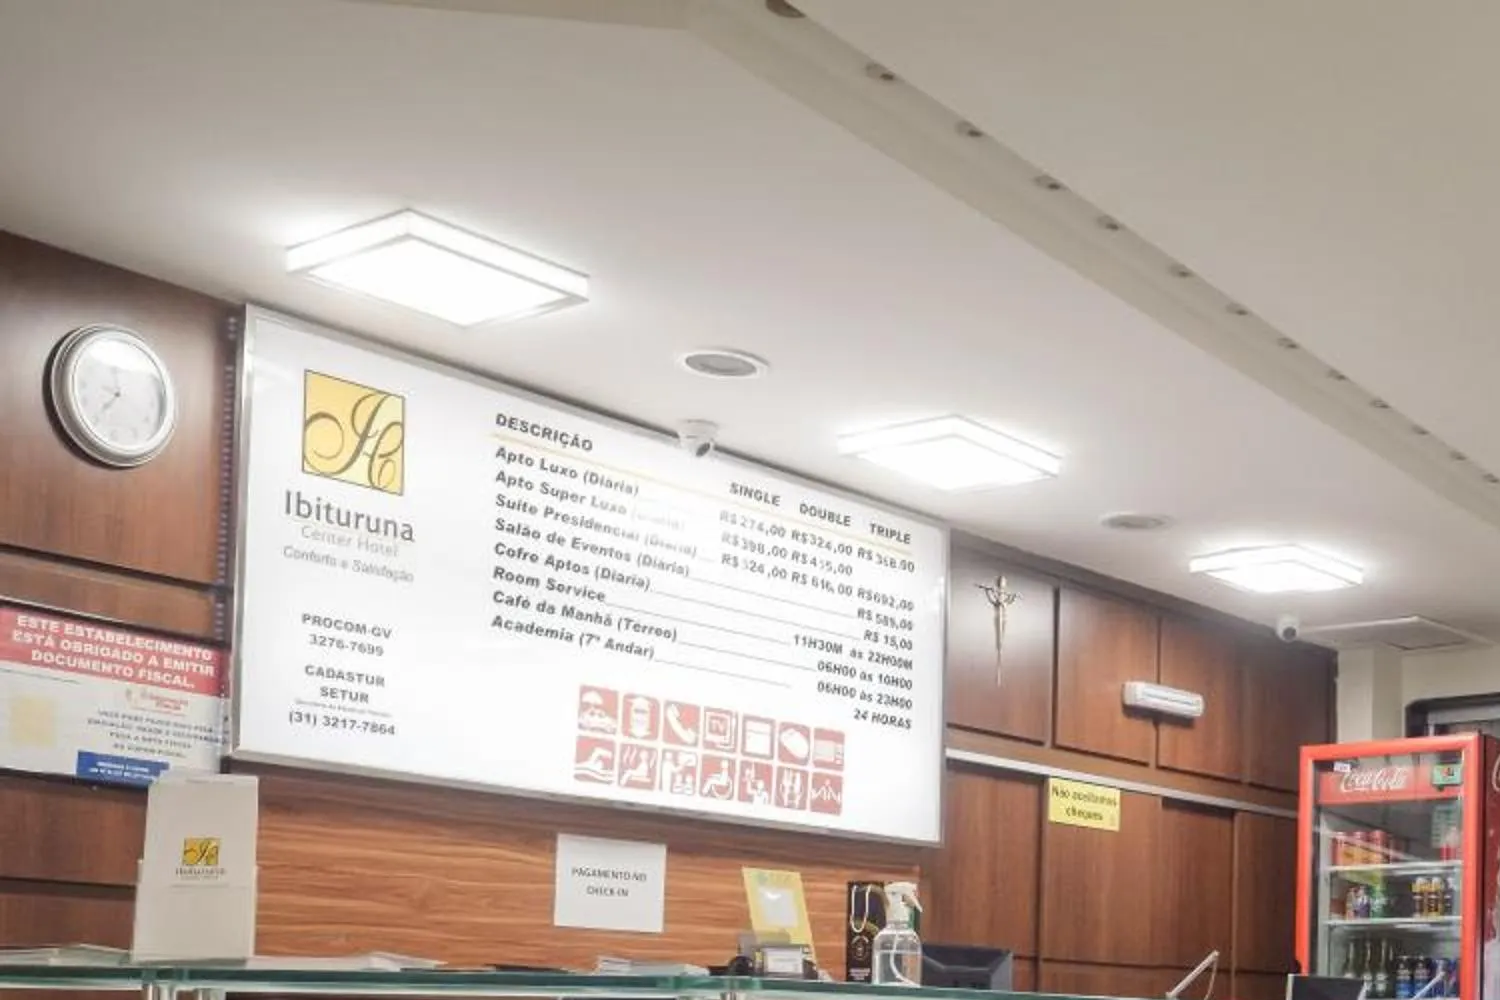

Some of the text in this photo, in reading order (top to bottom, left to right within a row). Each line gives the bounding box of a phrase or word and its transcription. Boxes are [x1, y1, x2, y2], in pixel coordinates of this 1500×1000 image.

[495, 413, 593, 452] DESCRIÇÃO
[495, 447, 535, 467] Apto
[540, 458, 578, 479] Luxo
[495, 470, 627, 516] Apto Super Luxo
[284, 490, 415, 542] Ibituruna
[544, 505, 640, 542] Presidencial
[730, 482, 911, 545] SINGLE DOUBLE TRIPLE
[301, 524, 399, 558] Center Hotel
[494, 542, 539, 563] Cofre
[544, 553, 590, 575] Aptos
[495, 517, 541, 540] Salão
[546, 530, 566, 547] de
[571, 537, 631, 563] Eventos
[493, 565, 606, 602] Room Service
[493, 590, 531, 610] Café
[536, 599, 556, 615] da
[561, 605, 613, 627] Manhã
[13, 630, 215, 677] ESTÁ OBRIGADO A EMITIR
[17, 615, 213, 661] ESTE ESTABELECIMENTO
[491, 614, 575, 643] Academia
[604, 638, 655, 660] Andar)
[794, 633, 843, 654] 11H30M
[31, 649, 134, 678] DOCUMENTO
[138, 668, 196, 689] FISCAL.
[304, 664, 386, 688] CADASTUR
[319, 686, 370, 704] SETUR
[288, 710, 318, 727] (31)
[853, 708, 912, 730] 24 HORAS
[1341, 766, 1407, 793] Coca-Cola
[571, 866, 631, 881] PAGAMENTO
